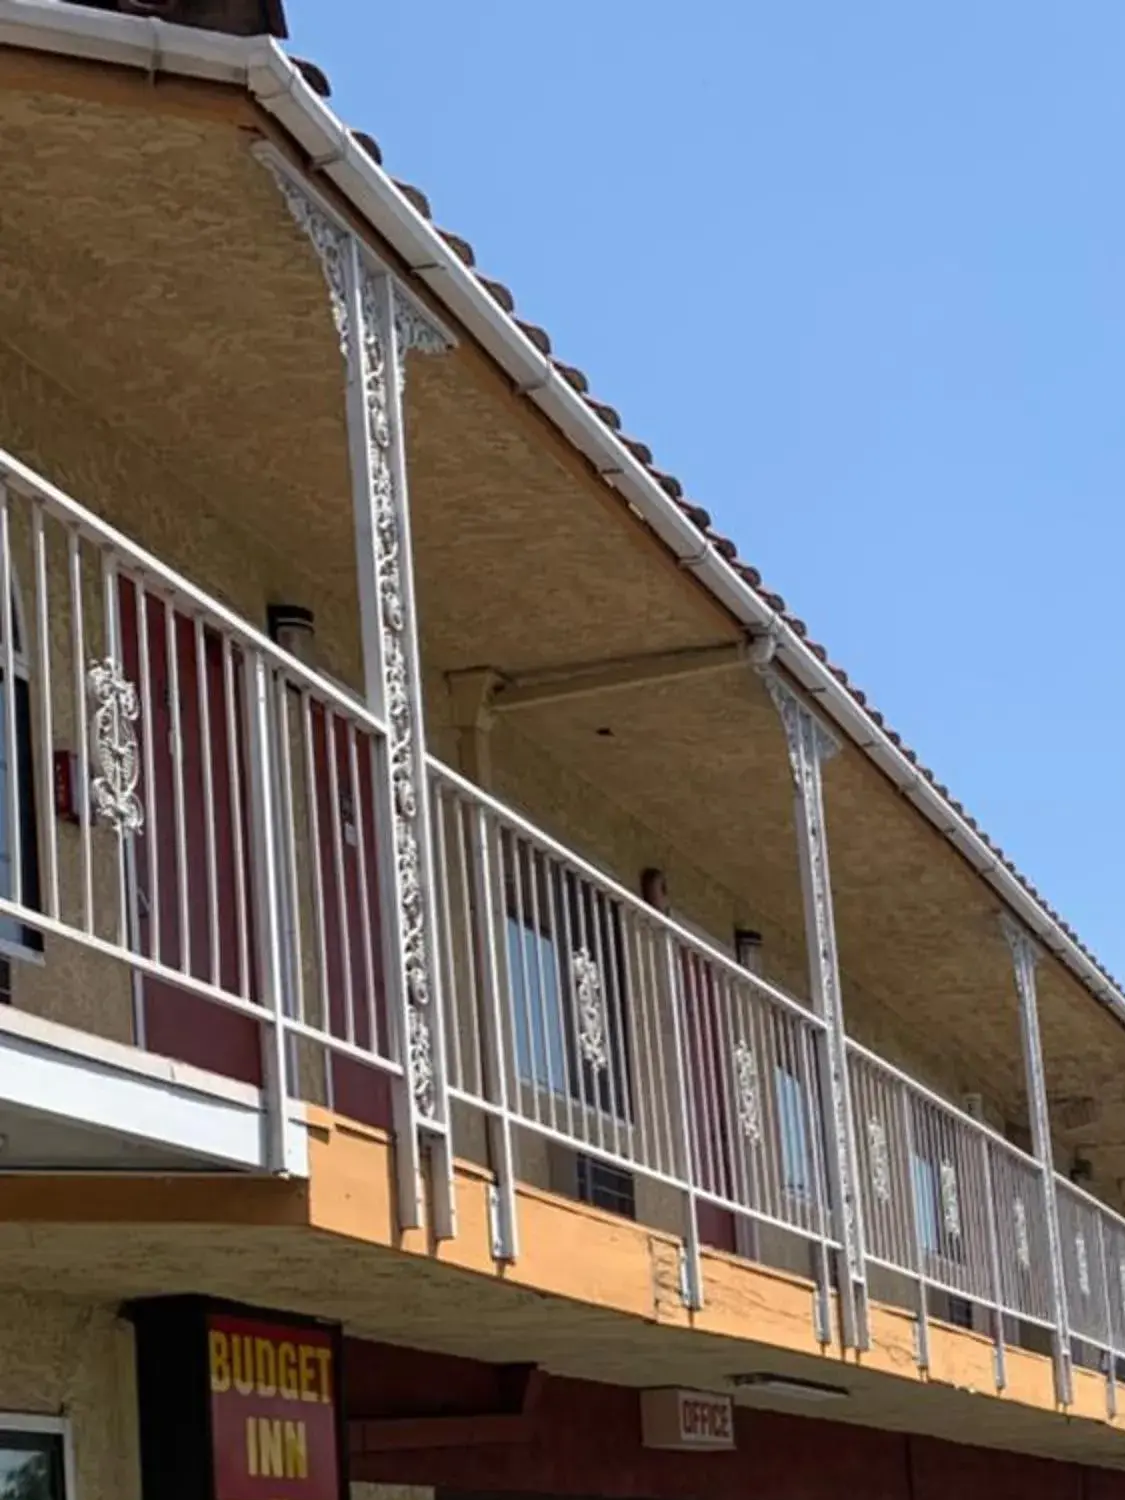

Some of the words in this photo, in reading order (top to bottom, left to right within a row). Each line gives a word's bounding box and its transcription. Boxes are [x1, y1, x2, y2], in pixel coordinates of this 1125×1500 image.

[209, 1330, 333, 1403] BUDGET
[246, 1416, 308, 1479] INN
[683, 1399, 730, 1438] OFFICE
